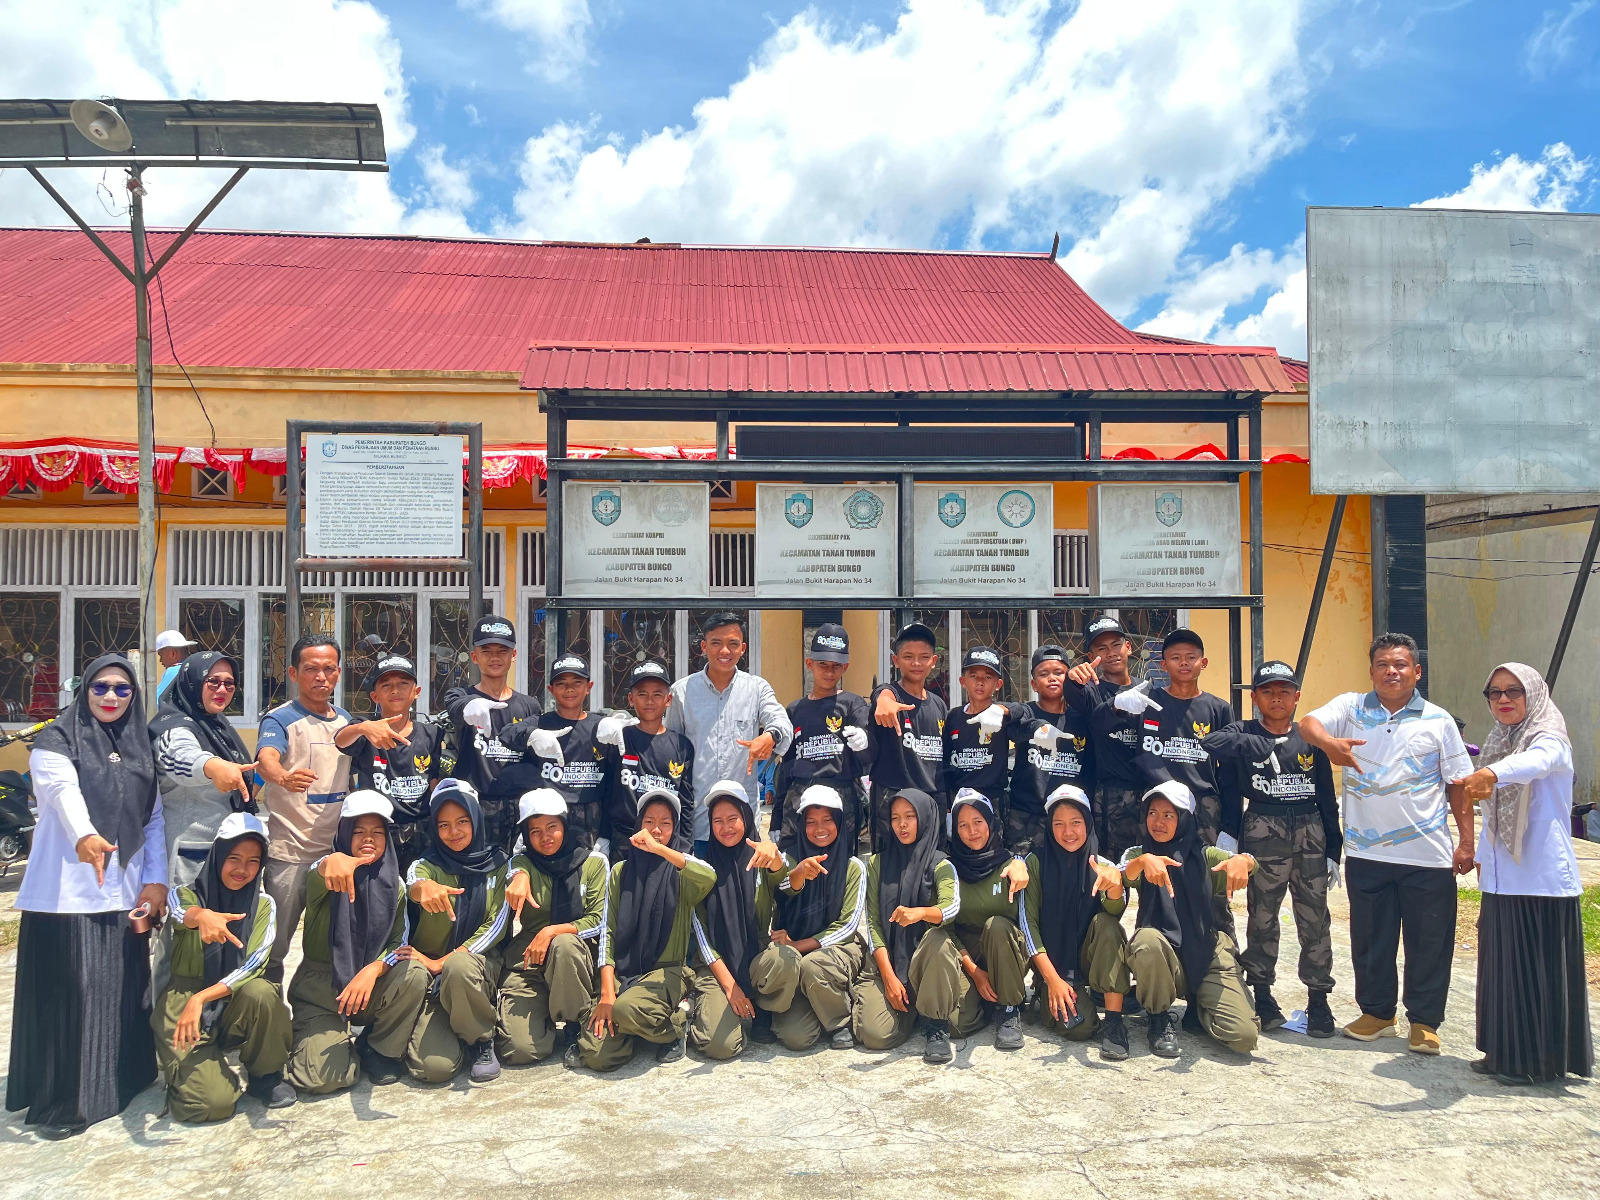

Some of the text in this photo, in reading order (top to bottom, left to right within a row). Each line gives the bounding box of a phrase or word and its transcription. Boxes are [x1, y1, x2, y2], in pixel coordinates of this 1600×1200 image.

[588, 547, 686, 556] KECAMATAN TANAH TUMBUH
[780, 549, 876, 557] KECAMATAN TANAH TUMBUH
[934, 548, 1030, 557] KECAMATAN TANAH TUMBUH
[1120, 550, 1220, 559] KECAMATAN TANAH TUMBUH
[605, 562, 672, 571] KABUPATEN BUNGO
[796, 564, 862, 573] KABUPATEN BUNGO
[950, 563, 1016, 572] KABUPATEN BUNGO
[1136, 566, 1205, 575] KABUPATEN BUNGO
[633, 576, 662, 584] Harapan
[823, 577, 852, 585] Harapan
[977, 577, 1006, 585] Harapan
[1165, 581, 1195, 589] Harapan
[803, 738, 839, 748] REPUBLIK
[915, 739, 943, 747] REPUBLI
[1142, 735, 1164, 756] 80
[1164, 740, 1204, 751] REPUBLIK
[1164, 747, 1203, 757] INDONESIA
[1027, 748, 1044, 769] 80
[540, 761, 564, 783] 80
[372, 772, 391, 795] 80
[620, 768, 640, 791] 80
[640, 775, 676, 791] REPUBLIK
[1270, 777, 1312, 786] REPUBLIK
[1251, 773, 1271, 796] 80
